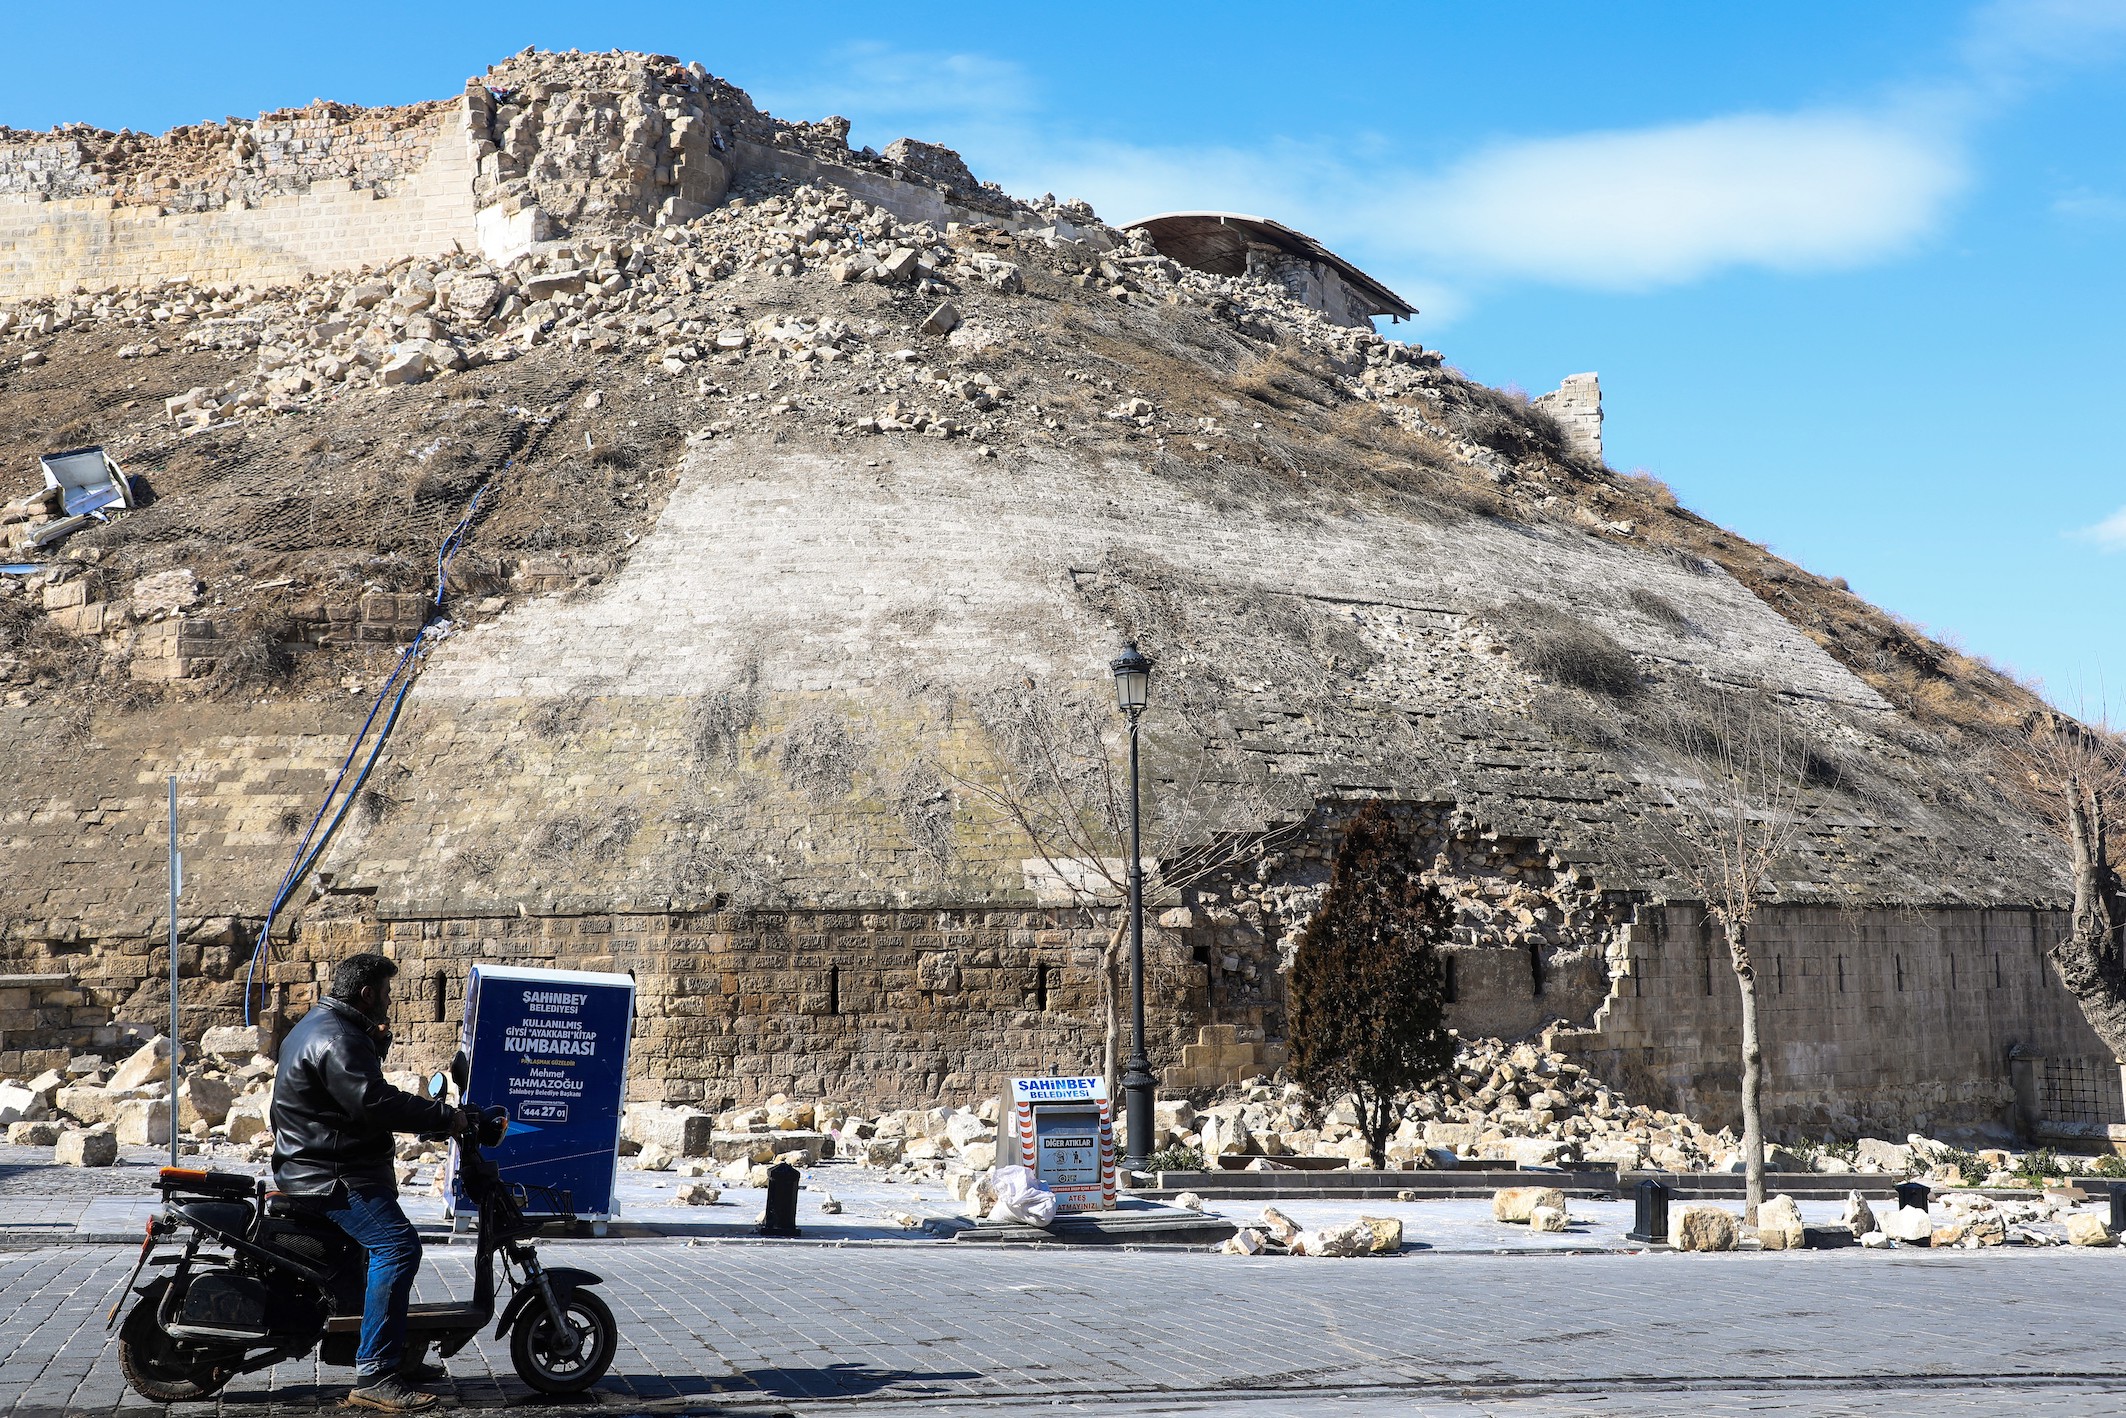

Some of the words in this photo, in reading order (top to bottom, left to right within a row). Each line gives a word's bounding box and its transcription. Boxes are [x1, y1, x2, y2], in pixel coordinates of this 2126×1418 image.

[522, 1018, 583, 1031] KULLANILMIŞ
[504, 1037, 596, 1056] KUMBARASI
[530, 1068, 565, 1078] Mehmet
[508, 1078, 584, 1090] TAHMAZOĞLU
[535, 1089, 559, 1097] Belediye
[524, 1108, 540, 1116] 444
[541, 1106, 556, 1117] 27
[556, 1110, 566, 1118] 01
[1065, 1139, 1091, 1147] ATIKLAR
